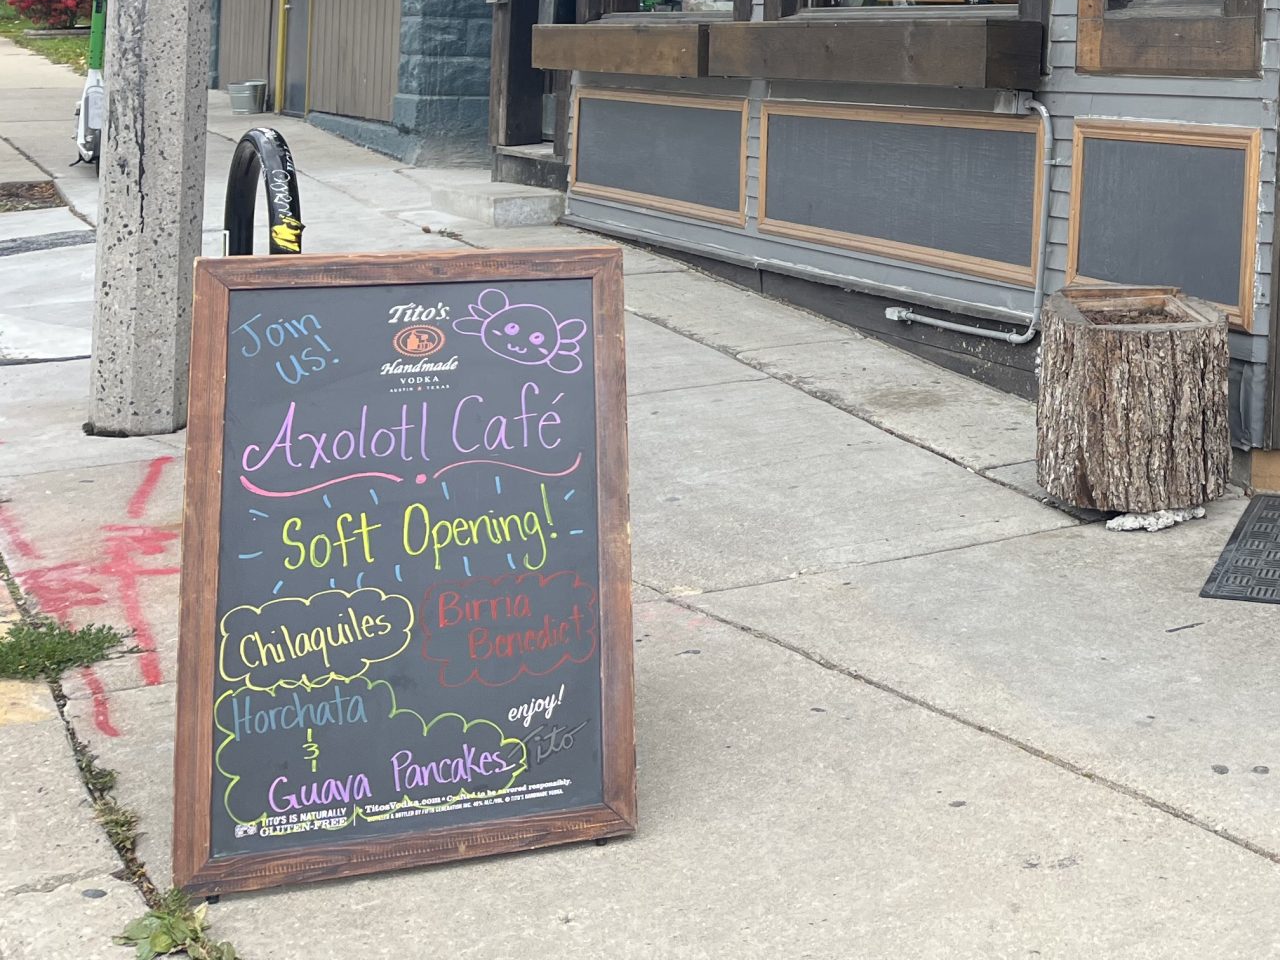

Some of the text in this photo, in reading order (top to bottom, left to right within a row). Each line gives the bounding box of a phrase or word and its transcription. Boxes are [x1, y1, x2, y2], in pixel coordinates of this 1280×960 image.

[233, 311, 322, 359] Join
[380, 356, 458, 375] Handmade
[400, 376, 439, 384] VODKA
[241, 381, 565, 472] Axolotl Café
[282, 483, 558, 570] Soft Opening!
[438, 589, 532, 628] Birria
[239, 607, 392, 668] Chilaquiles
[468, 606, 585, 661] Benedict
[232, 686, 369, 742] Horchata
[508, 684, 565, 728] enjoy!
[268, 743, 517, 813] Guava Pancakes
[259, 816, 348, 837] GLUTEN-FREE
[261, 807, 347, 827] TITO'S IS NATURALLY
[365, 796, 441, 813] TitosVodka.com
